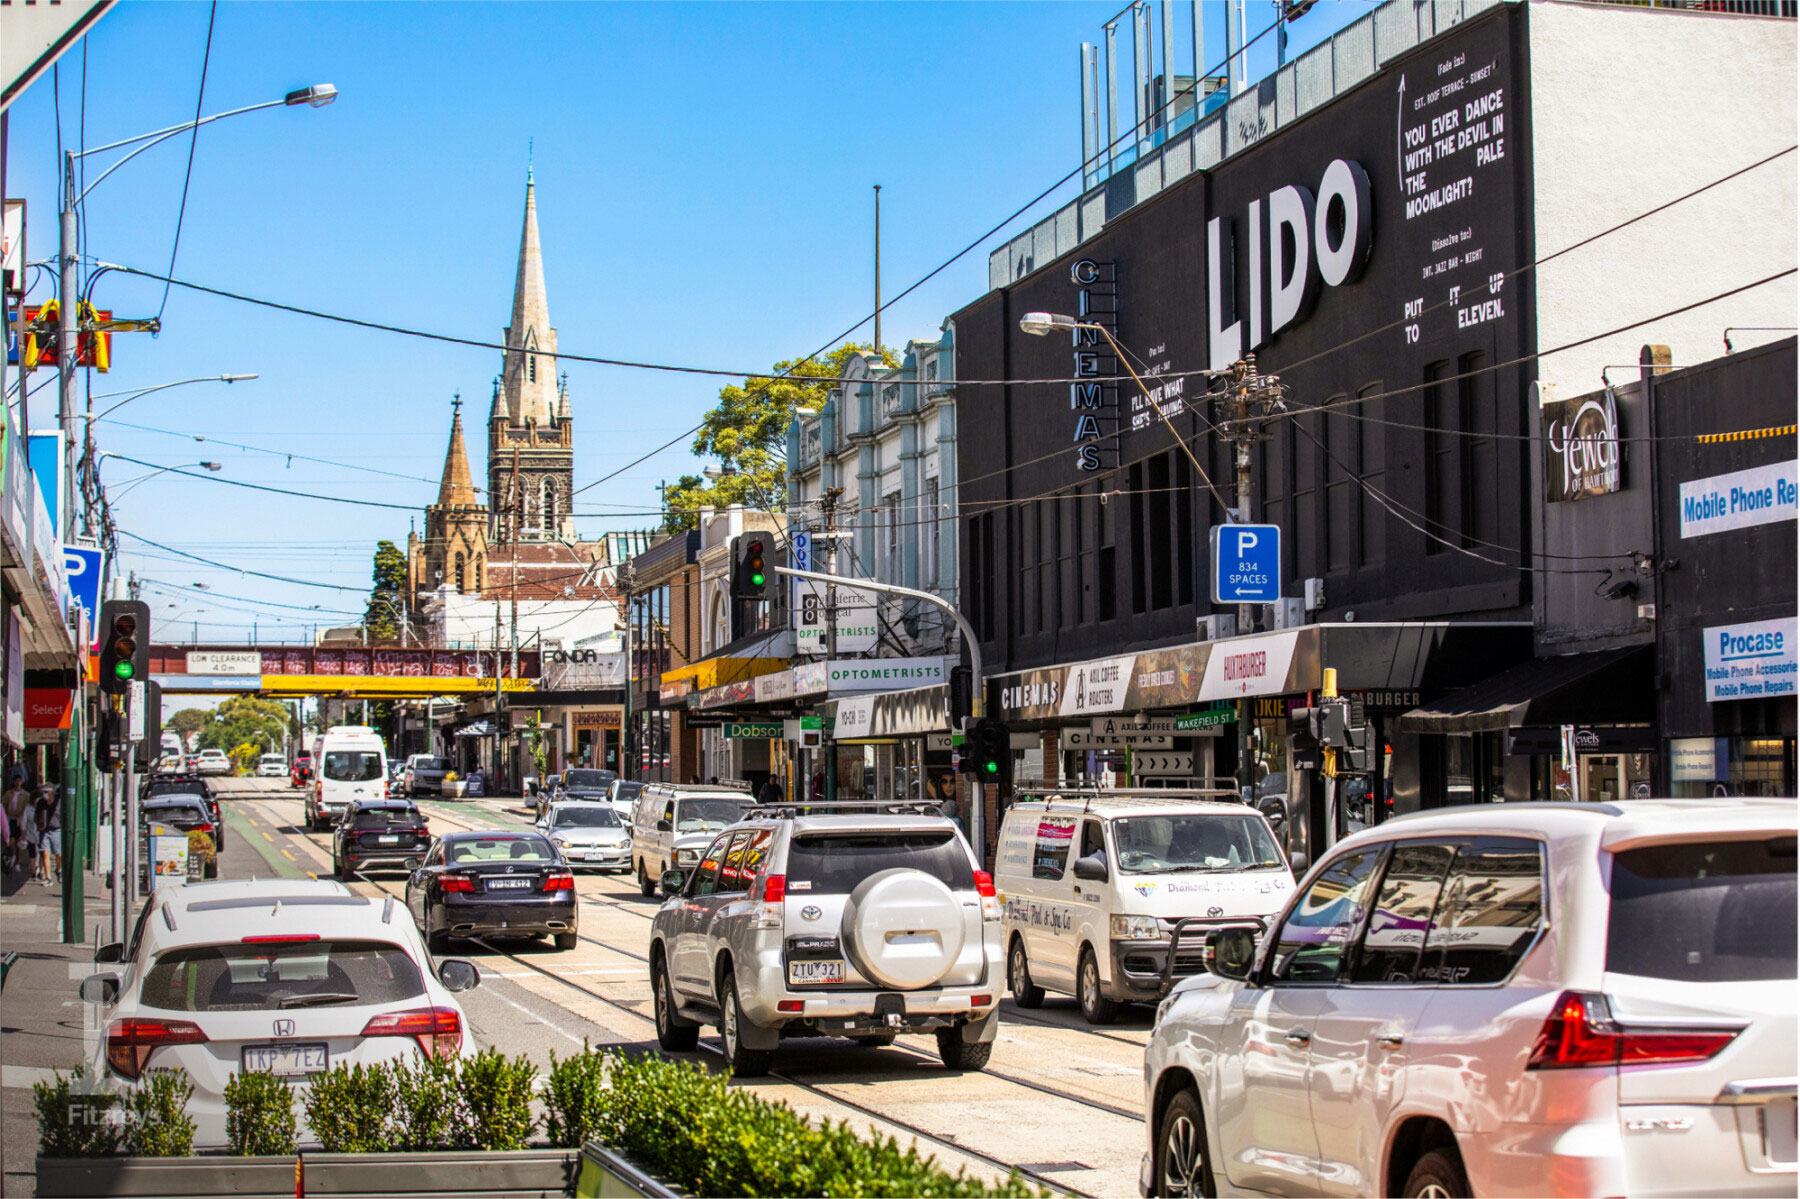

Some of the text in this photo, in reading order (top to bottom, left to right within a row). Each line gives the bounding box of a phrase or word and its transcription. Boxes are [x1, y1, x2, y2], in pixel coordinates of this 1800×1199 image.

[1414, 97, 1427, 111] EXT.
[1427, 88, 1441, 105] ROOF
[1441, 77, 1465, 97] TERRACE
[1470, 65, 1492, 84] SUNSET
[1405, 88, 1504, 148] YOU EVER DANCE
[1405, 113, 1504, 172] WITH THE DEVIL IN
[1405, 138, 1505, 195] THE PALE
[1406, 176, 1474, 220] MOONLIGHT?
[1431, 234, 1459, 252] (Dissolve
[1208, 158, 1366, 381] LIDO
[1435, 260, 1447, 275] JAZZ
[1448, 256, 1459, 270] BAR
[1465, 248, 1483, 264] NIGHT
[1404, 272, 1504, 320] PUT IT UP
[1405, 298, 1505, 344] TO ELEVEN.
[1071, 258, 1103, 473] CINEMAS
[1145, 386, 1163, 408] HAVE
[1163, 378, 1184, 399] WHAT
[1572, 477, 1582, 492] OF
[1684, 491, 1727, 522] Mobile
[1730, 486, 1773, 514] Phone
[1238, 532, 1258, 558] P
[1239, 562, 1258, 572] 834
[1229, 574, 1268, 584] SPACES
[1720, 631, 1784, 656] Procase
[191, 655, 256, 663] LOW CLEARANCE
[542, 649, 597, 664] FONDA
[1223, 651, 1267, 681] HUXTABURGER
[832, 667, 941, 680] OPTOMETRISTS
[1089, 669, 1100, 684] AXIL
[1101, 666, 1119, 683] COFFEE
[1707, 666, 1729, 680] Mobile
[1731, 665, 1753, 678] Phone
[1001, 681, 1059, 710] CINEMAS
[1089, 689, 1113, 706] ROASTERS
[1715, 679, 1794, 697] Mobile Phone Repairs
[32, 704, 64, 715] Select
[1177, 716, 1219, 730] WAKEFIELD
[1221, 713, 1230, 724] ST
[1071, 733, 1166, 745] CINEMAS
[793, 963, 841, 977] ZTU 321
[292, 1048, 325, 1067] 7EZ
